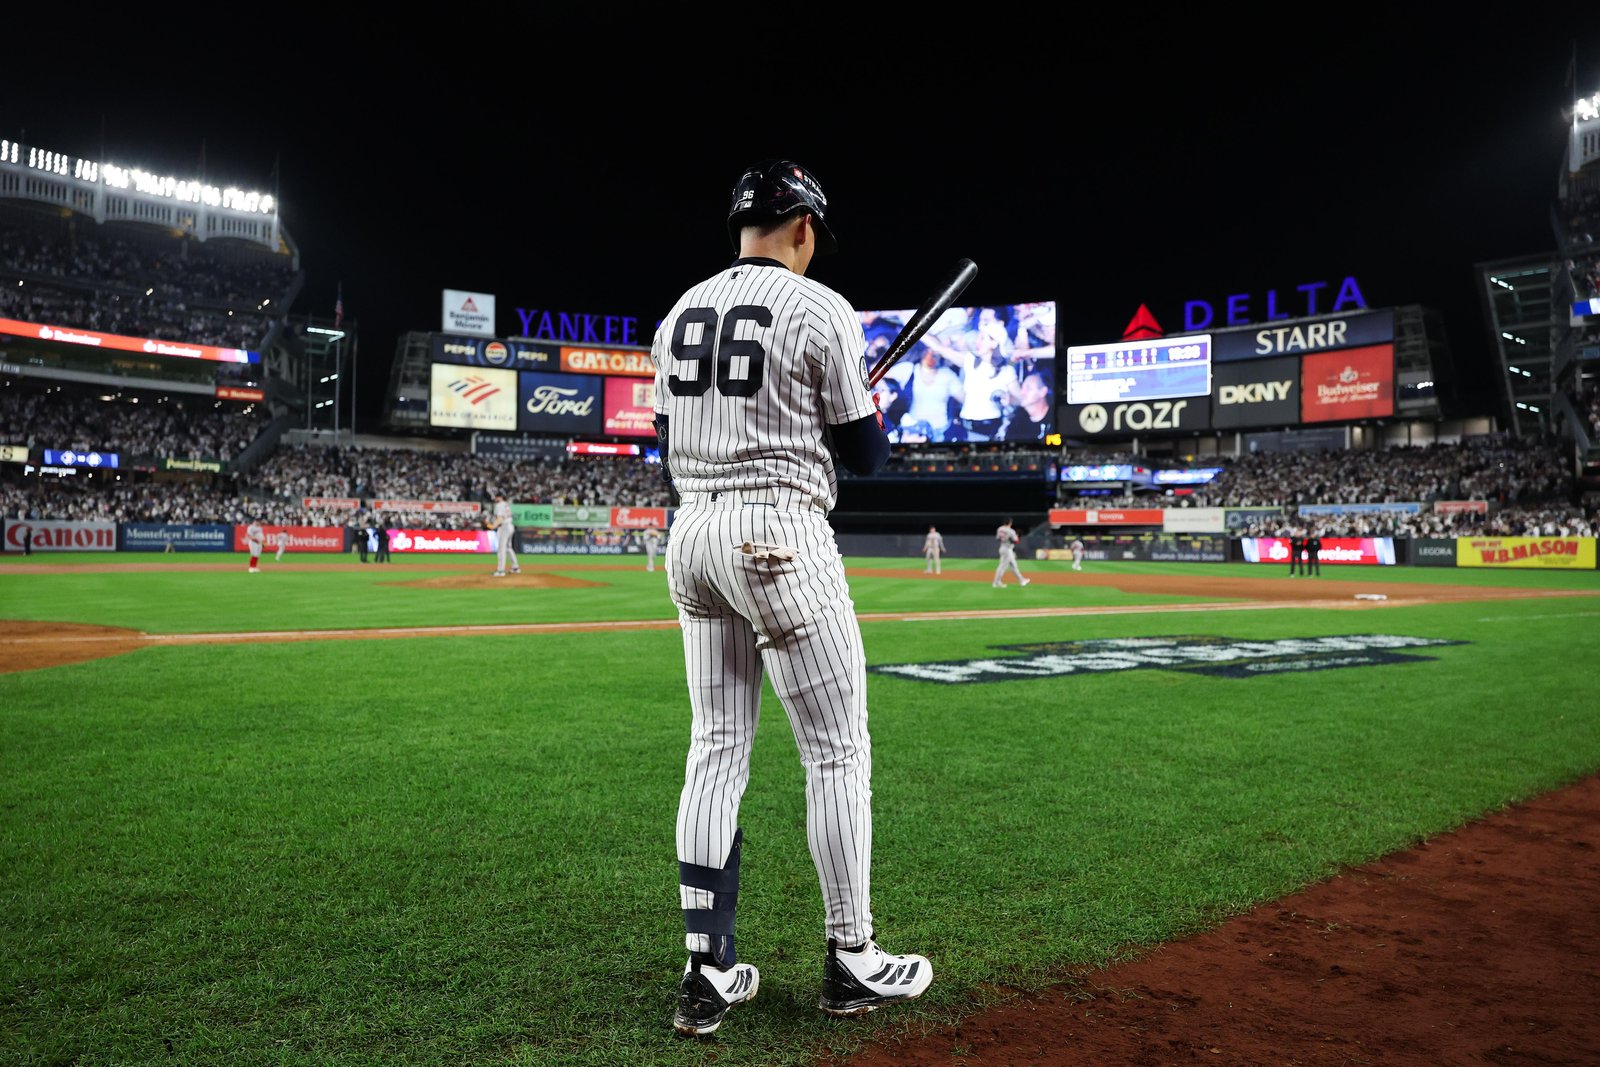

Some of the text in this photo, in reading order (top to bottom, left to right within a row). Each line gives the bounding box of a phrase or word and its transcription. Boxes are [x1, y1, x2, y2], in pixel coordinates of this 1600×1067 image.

[743, 190, 755, 200] 96
[1184, 276, 1367, 332] DELTA
[514, 306, 638, 346] YANKEE
[1255, 320, 1348, 355] STARR
[443, 343, 477, 356] PEPSI
[517, 350, 549, 362] PEPSI
[668, 304, 774, 397] 96
[1219, 380, 1292, 405] DKNY
[1317, 381, 1379, 397] Budweiser
[526, 385, 595, 416] Ford
[1113, 400, 1187, 430] razr
[524, 509, 550, 522] Eats
[7, 523, 114, 548] Canon
[184, 529, 225, 541] Einstein
[414, 534, 480, 550] Budweiser
[1418, 546, 1452, 556] LEGORA
